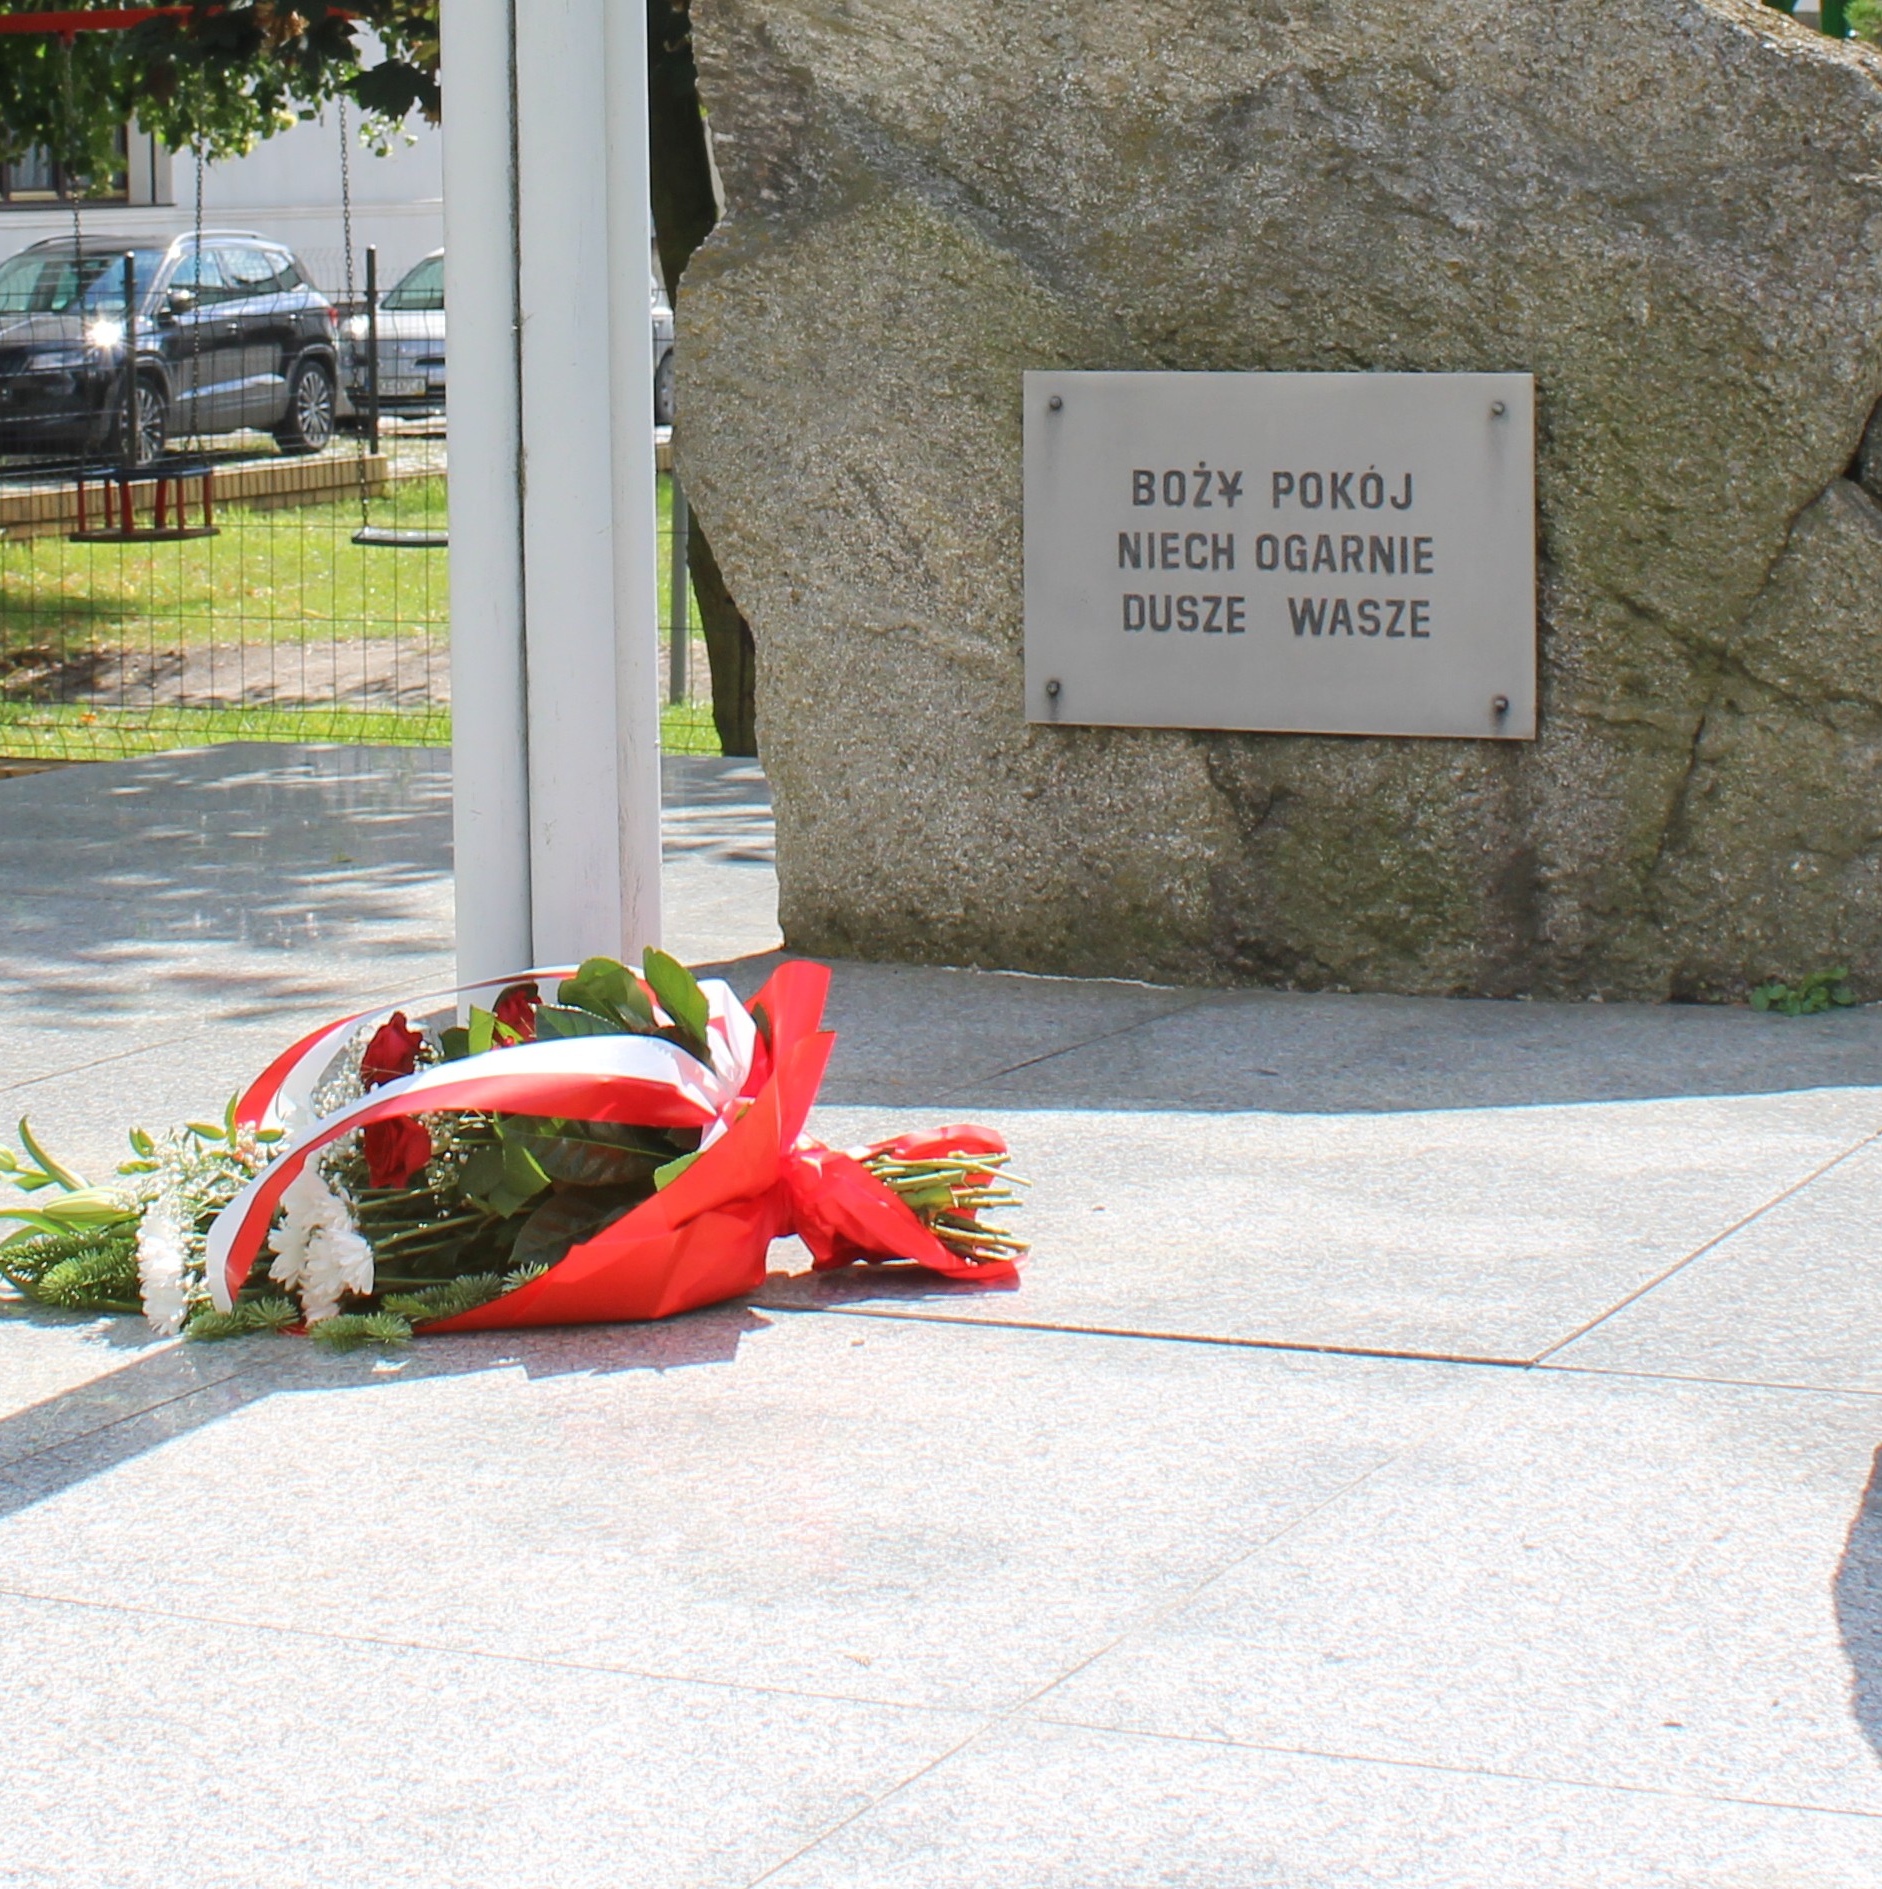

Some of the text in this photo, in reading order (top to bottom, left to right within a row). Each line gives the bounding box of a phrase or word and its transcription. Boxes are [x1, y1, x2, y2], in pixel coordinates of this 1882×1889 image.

[1132, 460, 1413, 511] BOŻY POKÓJ
[1117, 531, 1434, 576] NIECH OGARNIE
[1122, 593, 1431, 639] DUSZE WASZE
